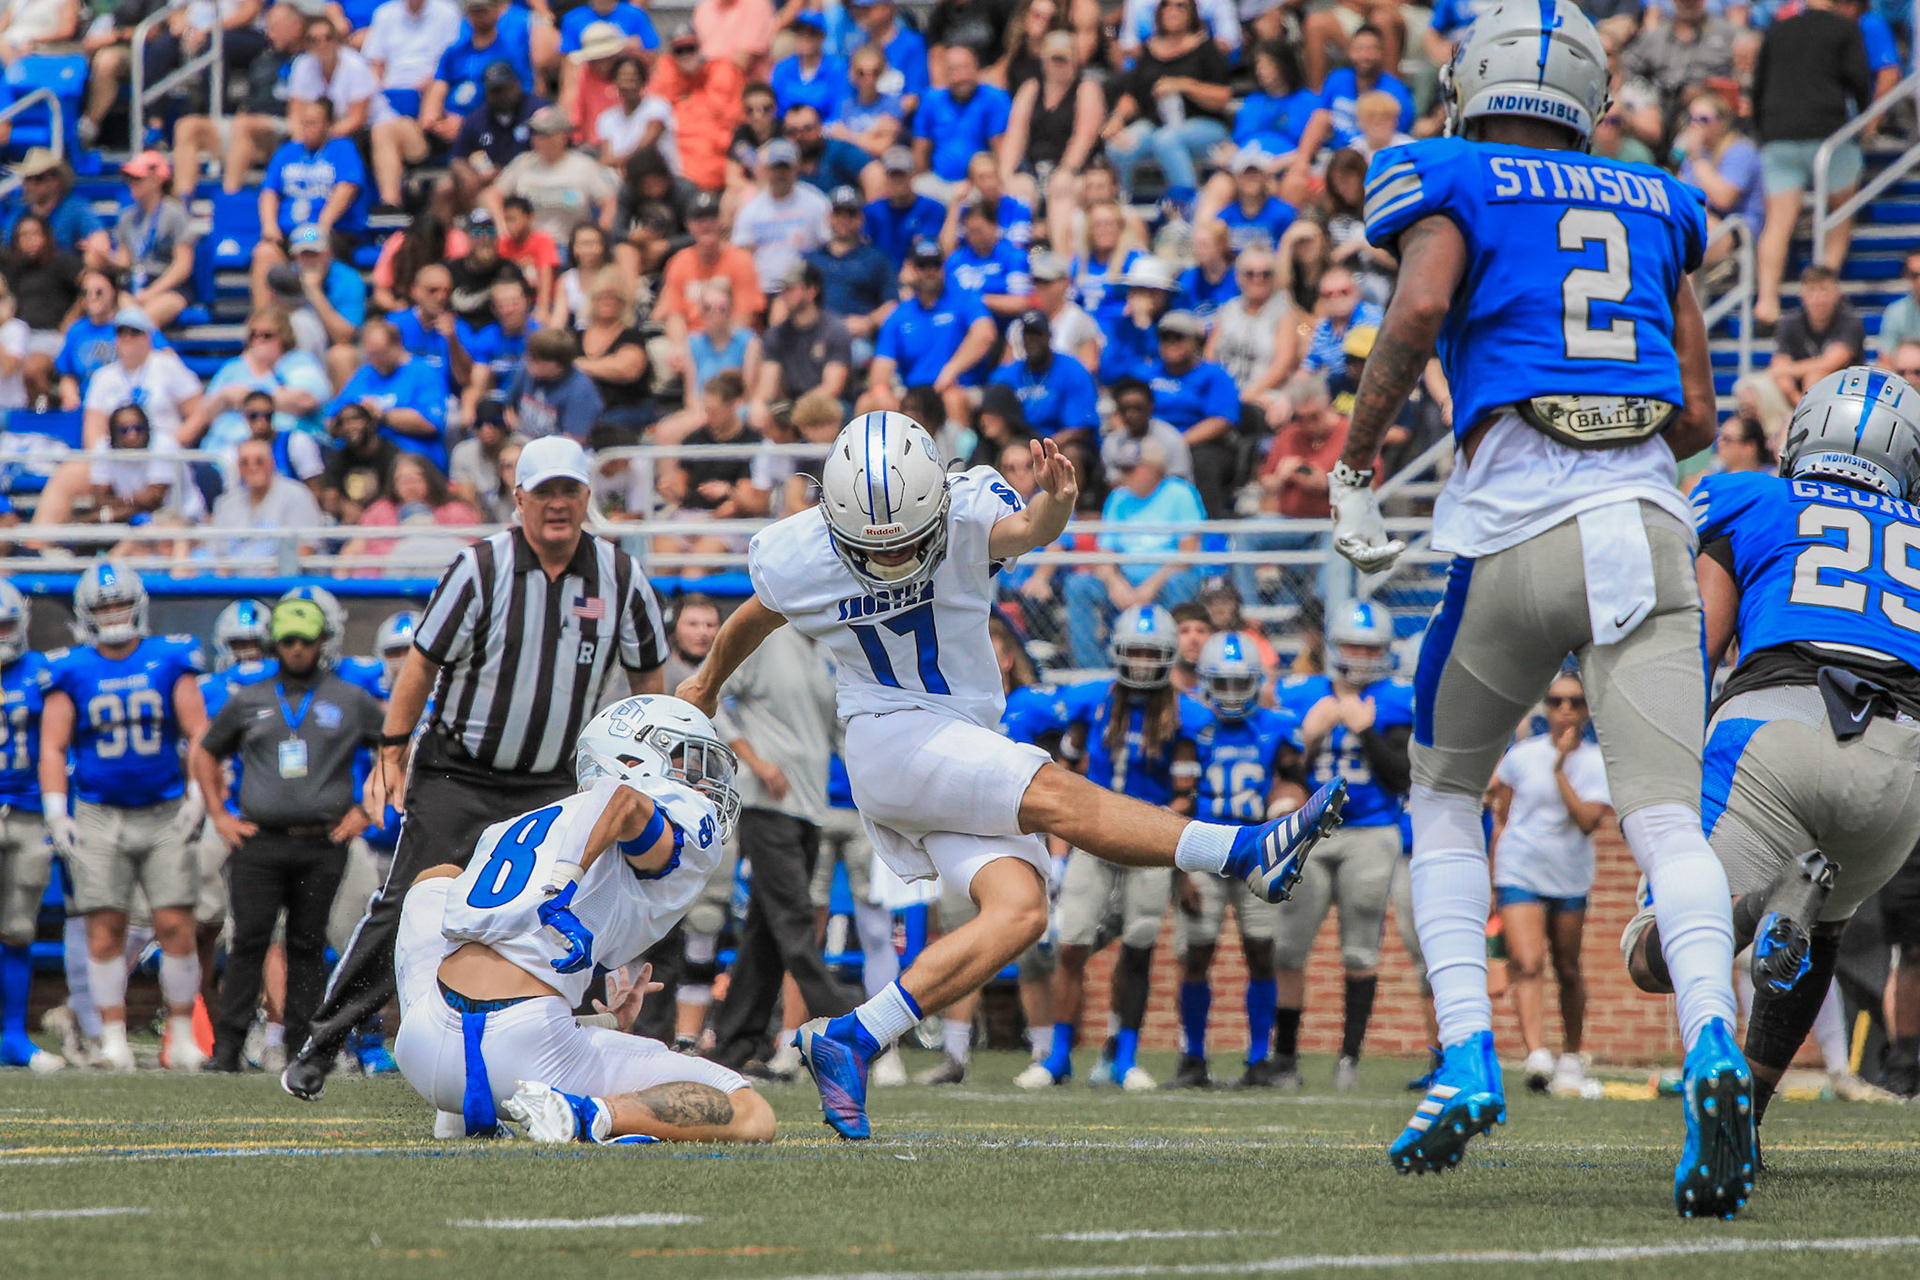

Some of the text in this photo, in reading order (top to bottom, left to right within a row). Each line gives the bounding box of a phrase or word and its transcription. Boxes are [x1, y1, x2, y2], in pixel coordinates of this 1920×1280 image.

[1487, 96, 1579, 123] INDIVISIBLE
[1490, 156, 1671, 216] STINSON
[1557, 207, 1639, 363] 2
[1822, 454, 1877, 475] INDIVISIBLE
[866, 527, 901, 536] Riddell
[577, 641, 594, 664] R
[847, 601, 951, 695] 17
[88, 689, 164, 759] 90
[1206, 762, 1265, 819] 16
[467, 805, 563, 909] 8
